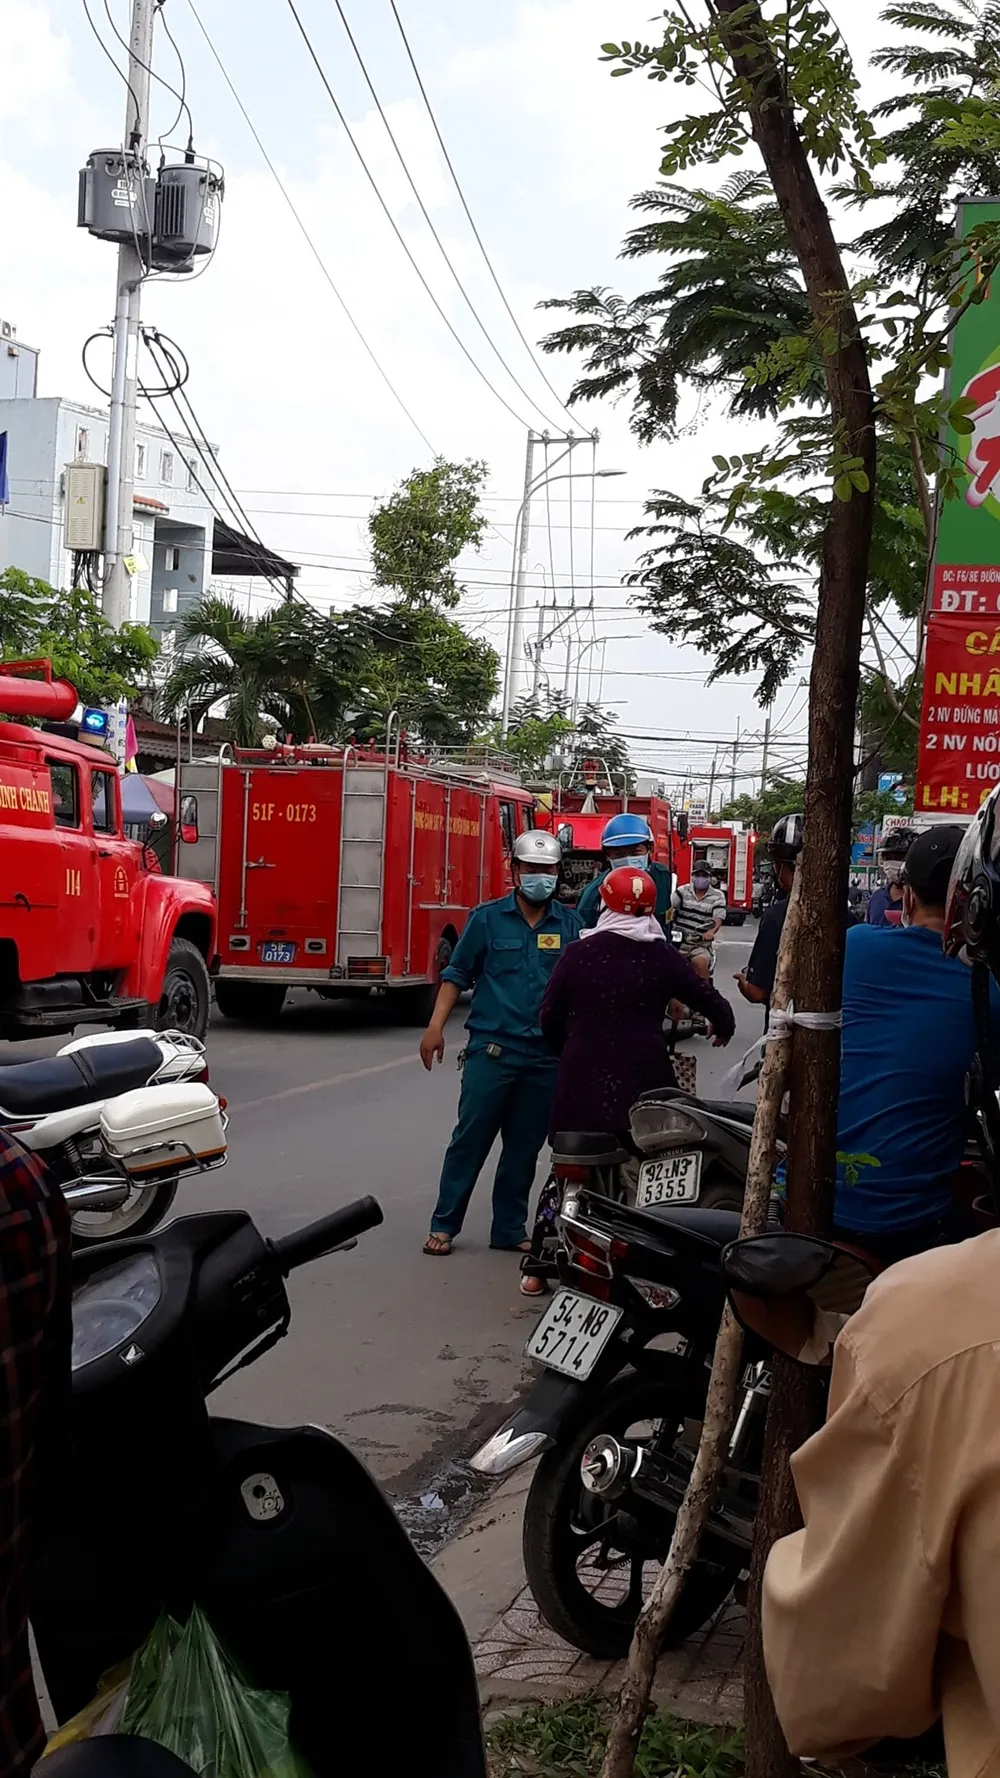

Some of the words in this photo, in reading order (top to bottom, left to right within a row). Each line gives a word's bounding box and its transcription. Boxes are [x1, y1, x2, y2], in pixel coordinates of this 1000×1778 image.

[941, 589, 987, 612] ĐT:
[928, 706, 935, 722] 2
[937, 707, 951, 722] NV
[953, 704, 981, 724] ĐỨNG
[983, 704, 1000, 724] MÁ
[925, 733, 938, 749] 2
[943, 734, 967, 751] NV
[922, 785, 969, 808] LH:
[252, 803, 275, 821] 51F
[286, 804, 317, 822] 0173
[66, 868, 81, 896] 114
[265, 951, 290, 962] 0173
[644, 1178, 686, 1203] 5355
[535, 1325, 590, 1370] 5714
